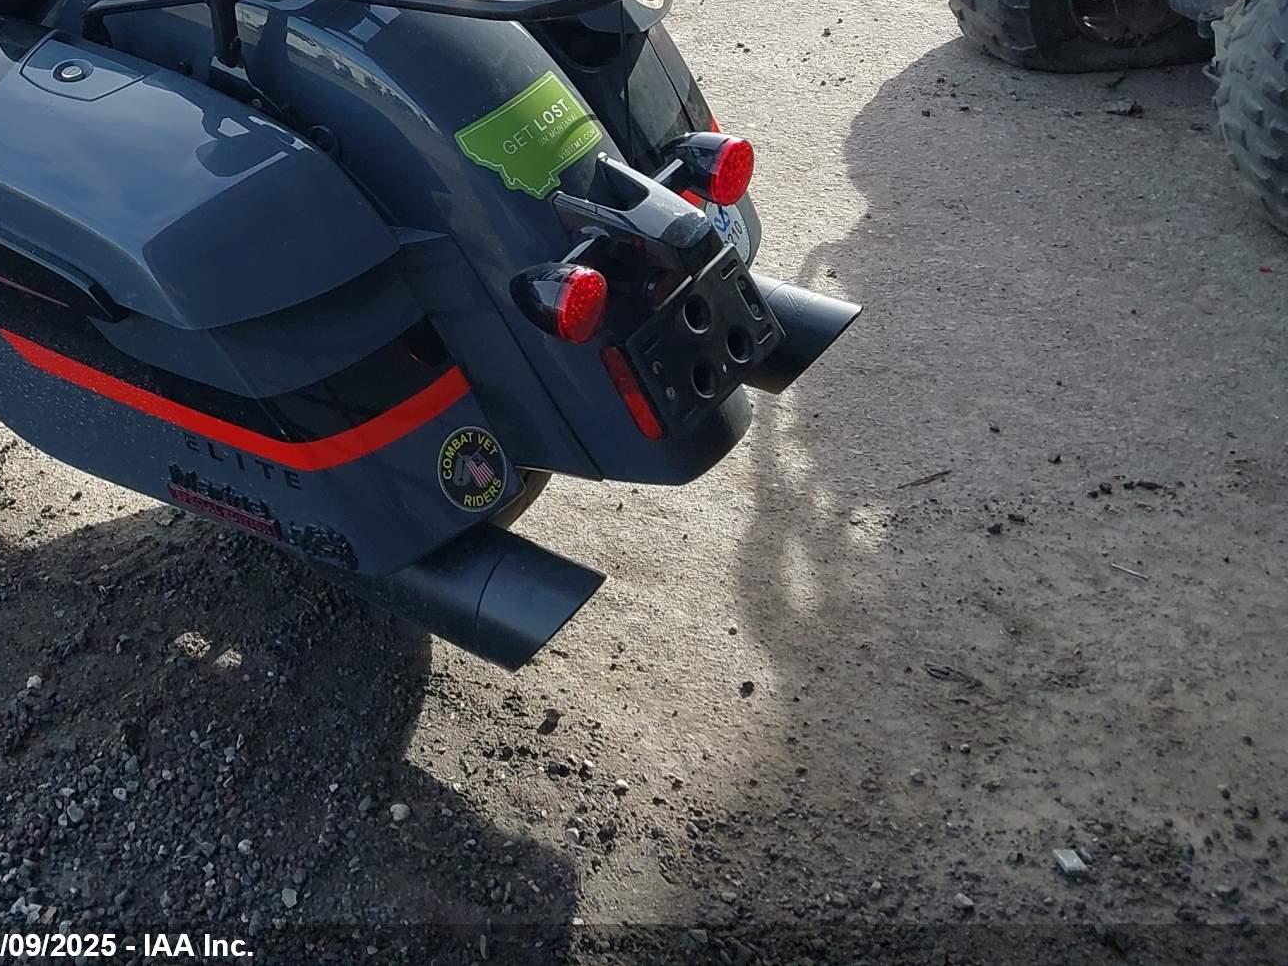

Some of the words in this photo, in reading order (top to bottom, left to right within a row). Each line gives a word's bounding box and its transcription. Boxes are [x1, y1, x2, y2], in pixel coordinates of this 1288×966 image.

[502, 124, 534, 155] GET
[533, 98, 570, 132] LOST
[184, 432, 303, 491] ELITE
[442, 431, 474, 480] COMBAT
[476, 433, 499, 455] VET
[463, 477, 502, 507] RIDERS
